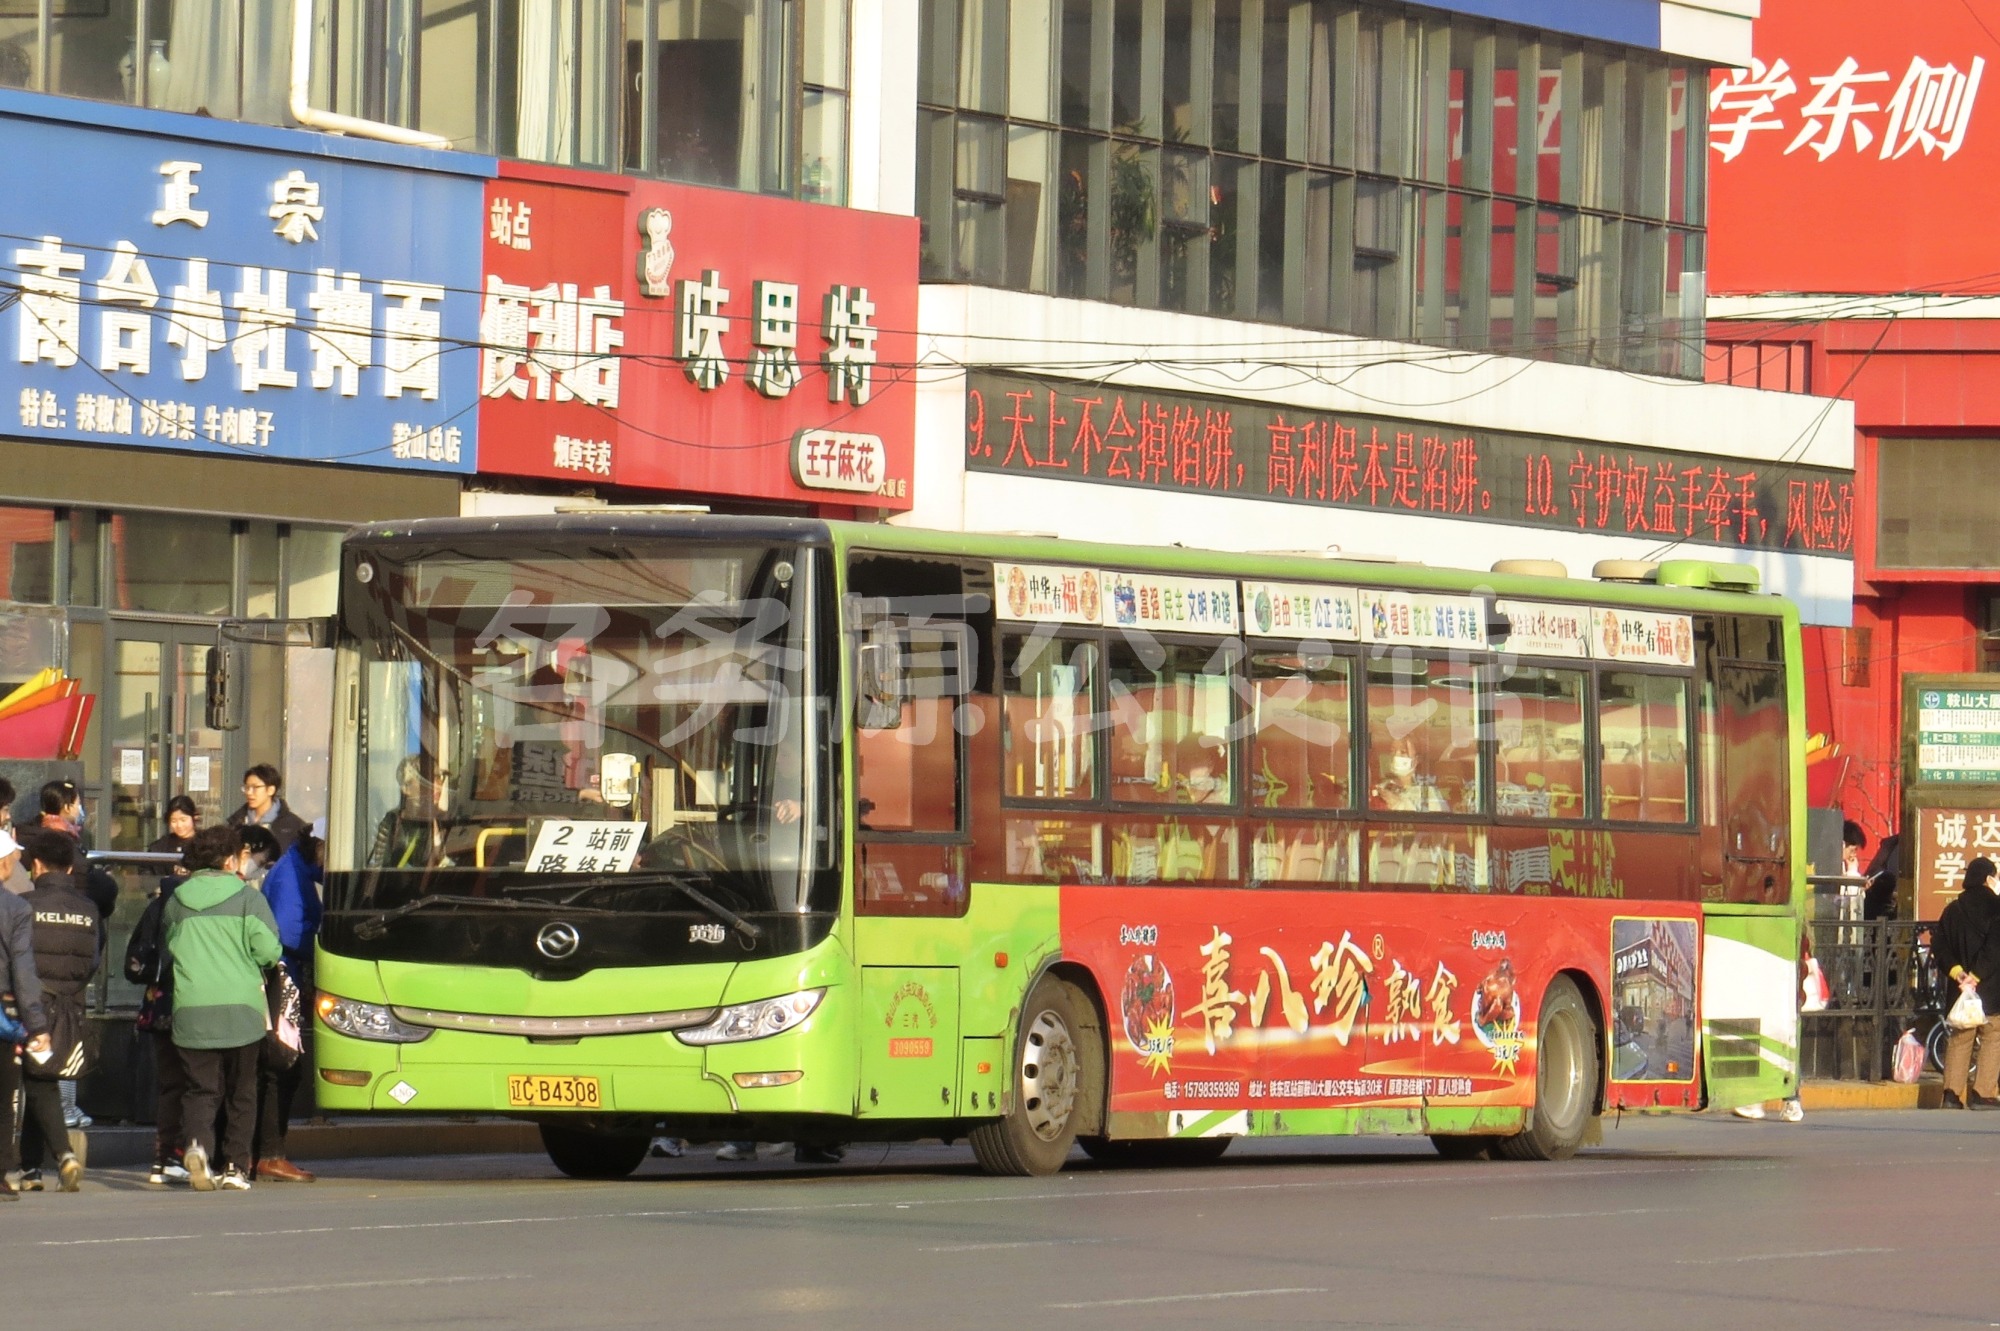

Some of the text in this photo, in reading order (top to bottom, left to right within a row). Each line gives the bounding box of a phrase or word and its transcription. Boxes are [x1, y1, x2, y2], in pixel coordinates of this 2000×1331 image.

[1709, 56, 1986, 163] 学东侧
[489, 197, 532, 251] 站点
[480, 273, 625, 409] 便利店
[674, 269, 877, 407] 味思特
[391, 421, 463, 465] 鞍山总店
[552, 434, 612, 477] 烟草专卖
[806, 439, 875, 484] 王子麻花
[1029, 574, 1078, 614] 中华有福
[1140, 584, 1160, 621] 富强
[1164, 587, 1184, 621] 民主
[1187, 588, 1208, 623] 文明
[1273, 593, 1291, 627] 自由
[1314, 596, 1332, 629] 公正
[1391, 603, 1410, 636] 爱国
[1435, 605, 1455, 639] 诚信
[1458, 606, 1477, 641] 友善
[1621, 619, 1674, 657] 中华有福
[553, 826, 574, 845] 2
[586, 827, 634, 851] 站前
[1934, 813, 2000, 848] 诚达
[537, 854, 568, 873] 路
[576, 855, 621, 873] 终点
[35, 912, 84, 925] KELME
[689, 925, 726, 943] 黄海
